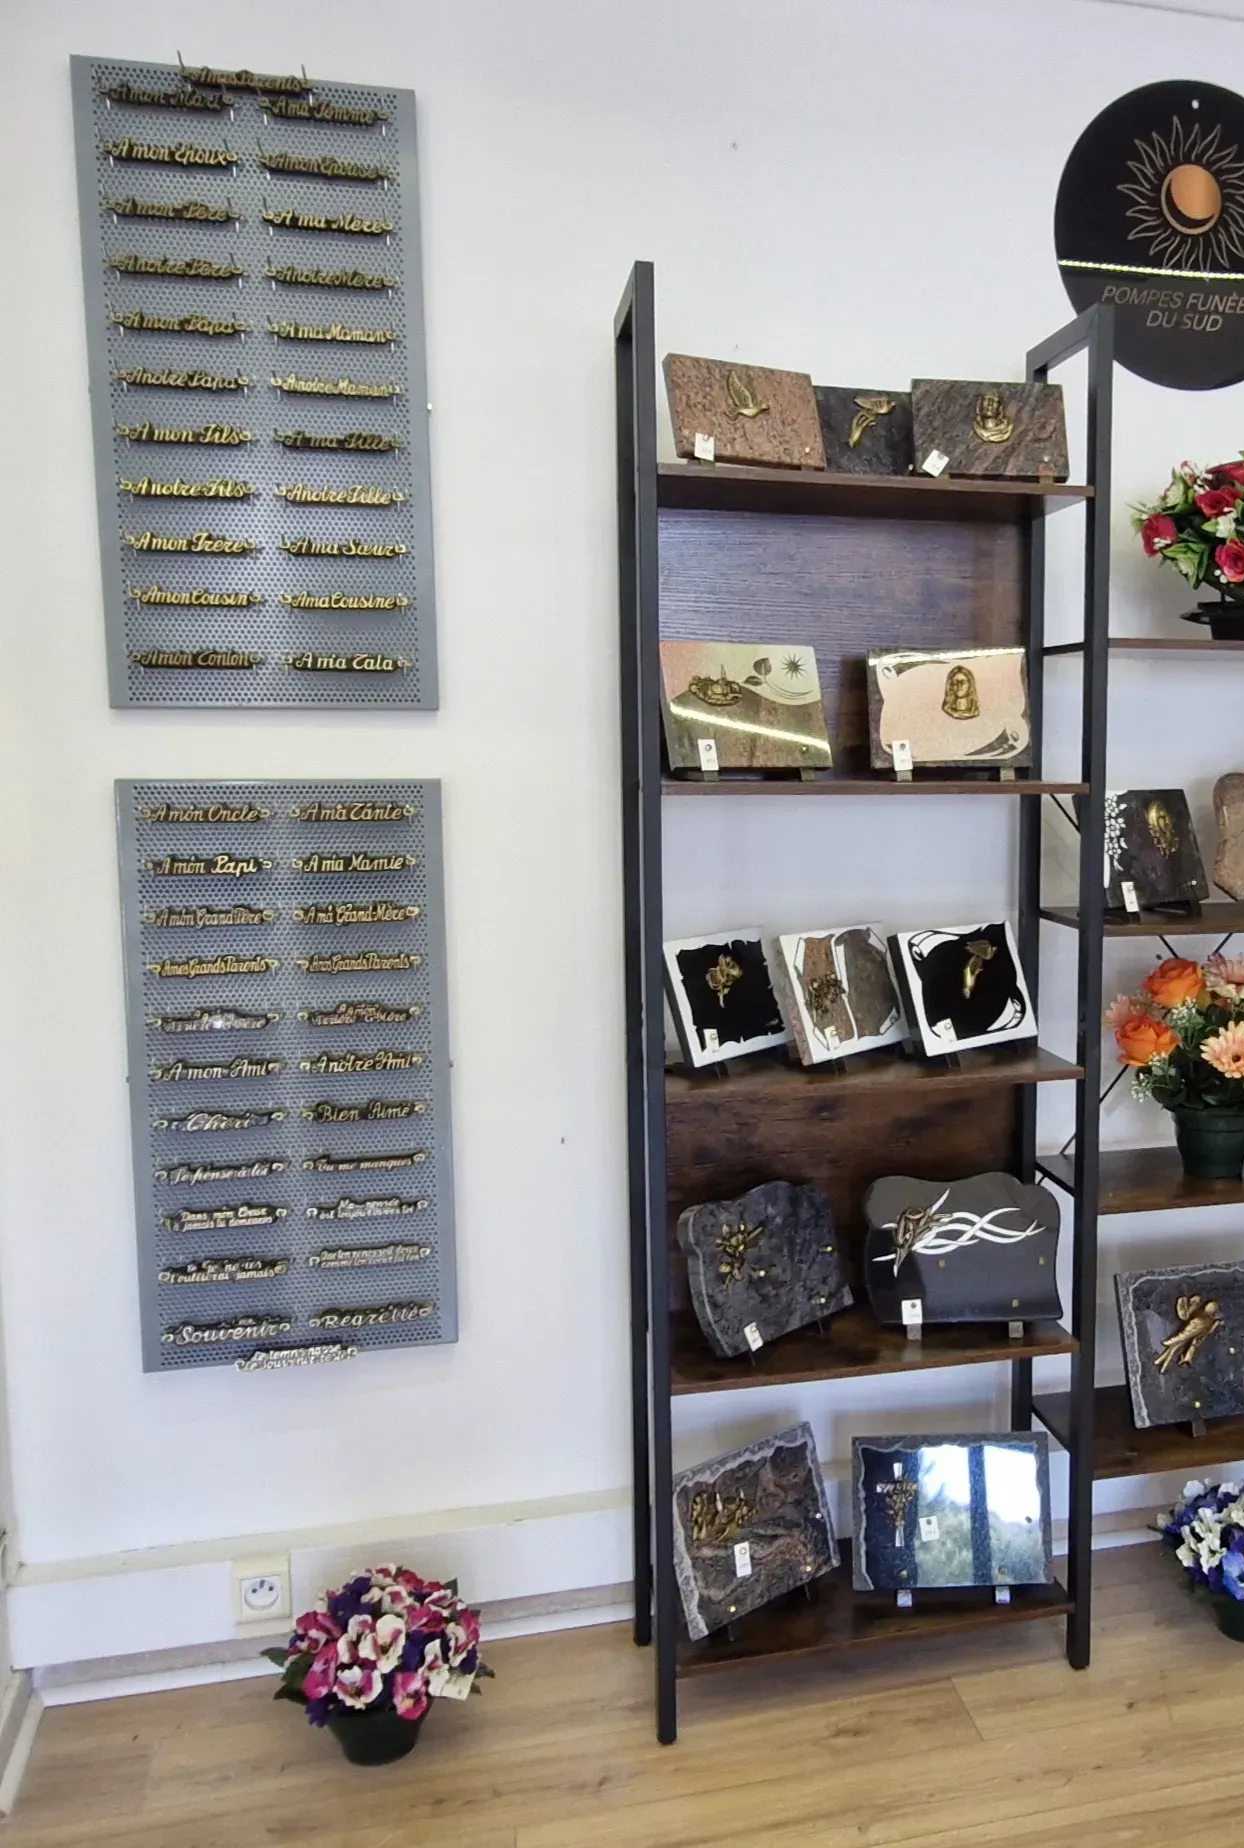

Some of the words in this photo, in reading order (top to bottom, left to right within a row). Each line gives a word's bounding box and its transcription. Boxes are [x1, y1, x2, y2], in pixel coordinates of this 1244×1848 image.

[298, 214, 328, 229] ma
[1100, 285, 1182, 309] POMPES
[1146, 311, 1177, 329] DU
[1180, 313, 1223, 333] SUD
[325, 323, 387, 343] Maman
[153, 428, 194, 442] mon
[199, 423, 240, 445] Fils
[311, 542, 340, 555] ma
[190, 588, 249, 606] Cousin
[331, 591, 396, 610] Cousine
[208, 803, 258, 822] Oncle
[211, 855, 258, 878] Papi
[348, 854, 404, 872] Mamie
[187, 1067, 222, 1080] mon
[230, 1059, 268, 1078] Ami
[375, 1051, 412, 1070] Ami
[320, 1104, 361, 1122] Bien
[360, 1158, 412, 1171] manques
[176, 1321, 278, 1346] Souvenir
